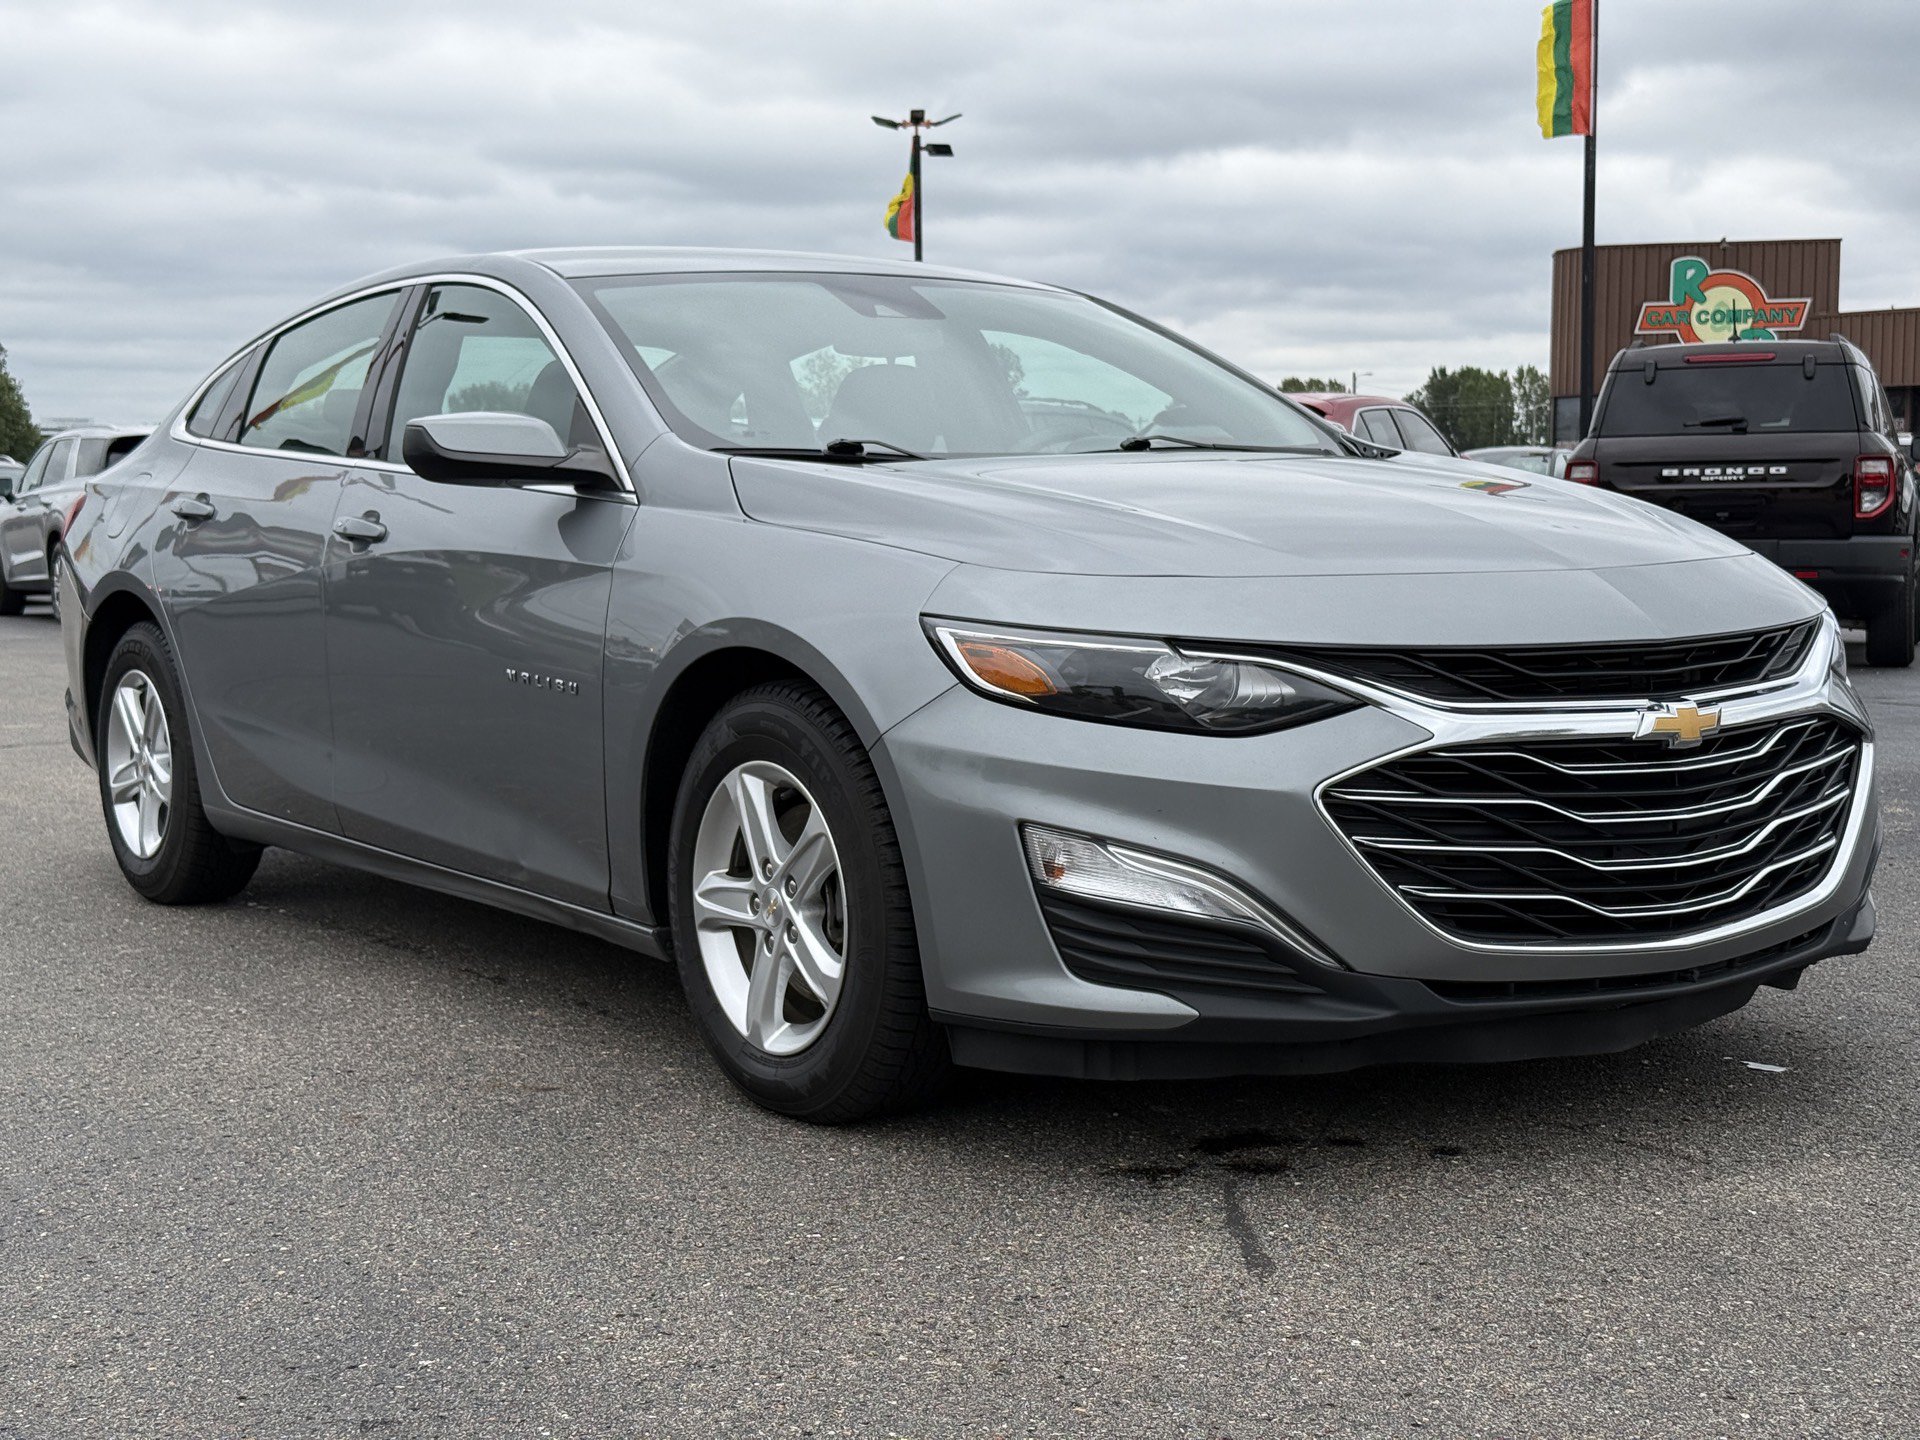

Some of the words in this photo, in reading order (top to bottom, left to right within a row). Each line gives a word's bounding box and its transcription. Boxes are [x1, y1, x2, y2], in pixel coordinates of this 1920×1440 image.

[1672, 259, 1708, 305] R
[1646, 311, 1690, 326] CAR
[1695, 307, 1799, 325] COMPANY
[1662, 466, 1787, 477] BRONCO
[506, 668, 579, 695] MALIBU
